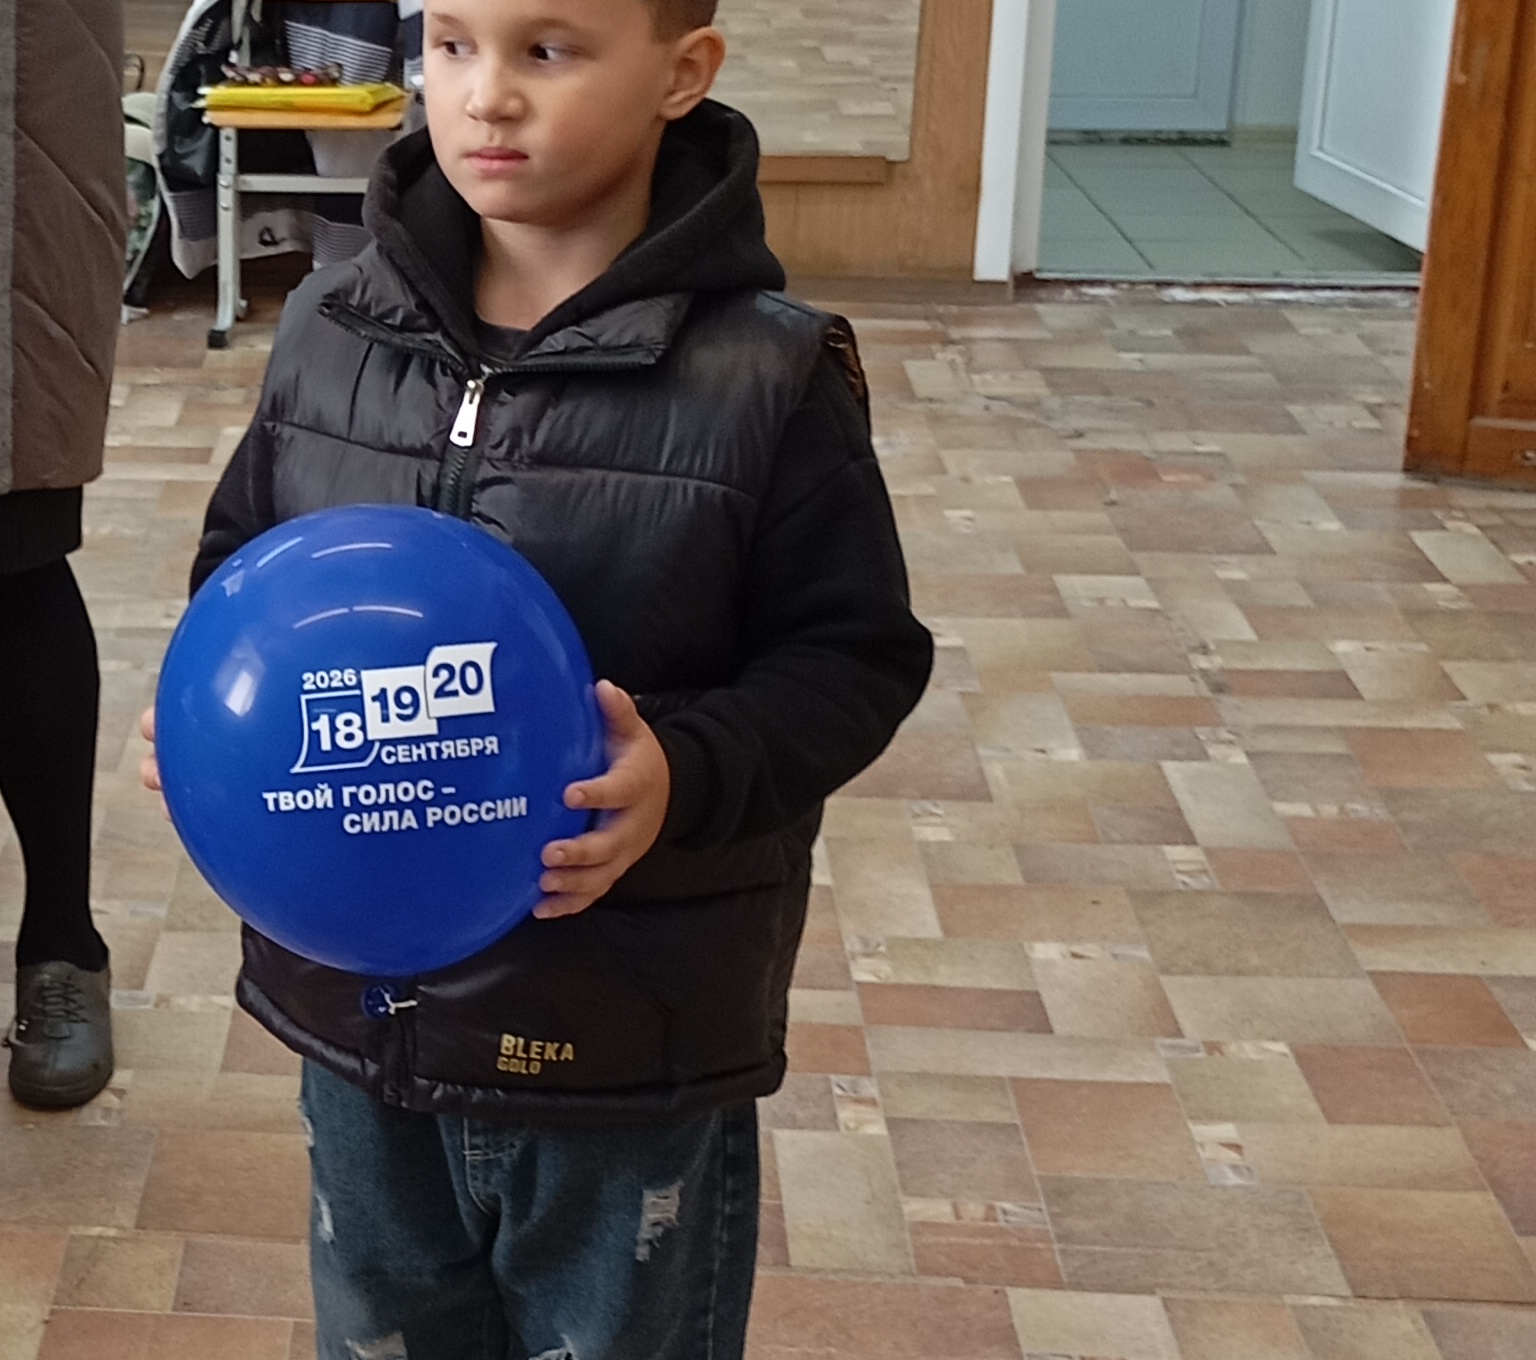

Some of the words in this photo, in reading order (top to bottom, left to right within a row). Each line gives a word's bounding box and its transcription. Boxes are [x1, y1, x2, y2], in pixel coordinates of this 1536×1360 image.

[301, 668, 359, 691] 2026
[310, 711, 365, 752] 18
[371, 685, 421, 723] 19
[432, 660, 484, 700] 20
[380, 736, 499, 765] СЕНТЯБРЯ
[262, 783, 334, 812] ТВОЙ
[342, 779, 435, 807] ГОЛОС
[343, 809, 419, 834] СИЛА
[426, 796, 528, 828] РОССИИ
[500, 1033, 574, 1061] BLEKA
